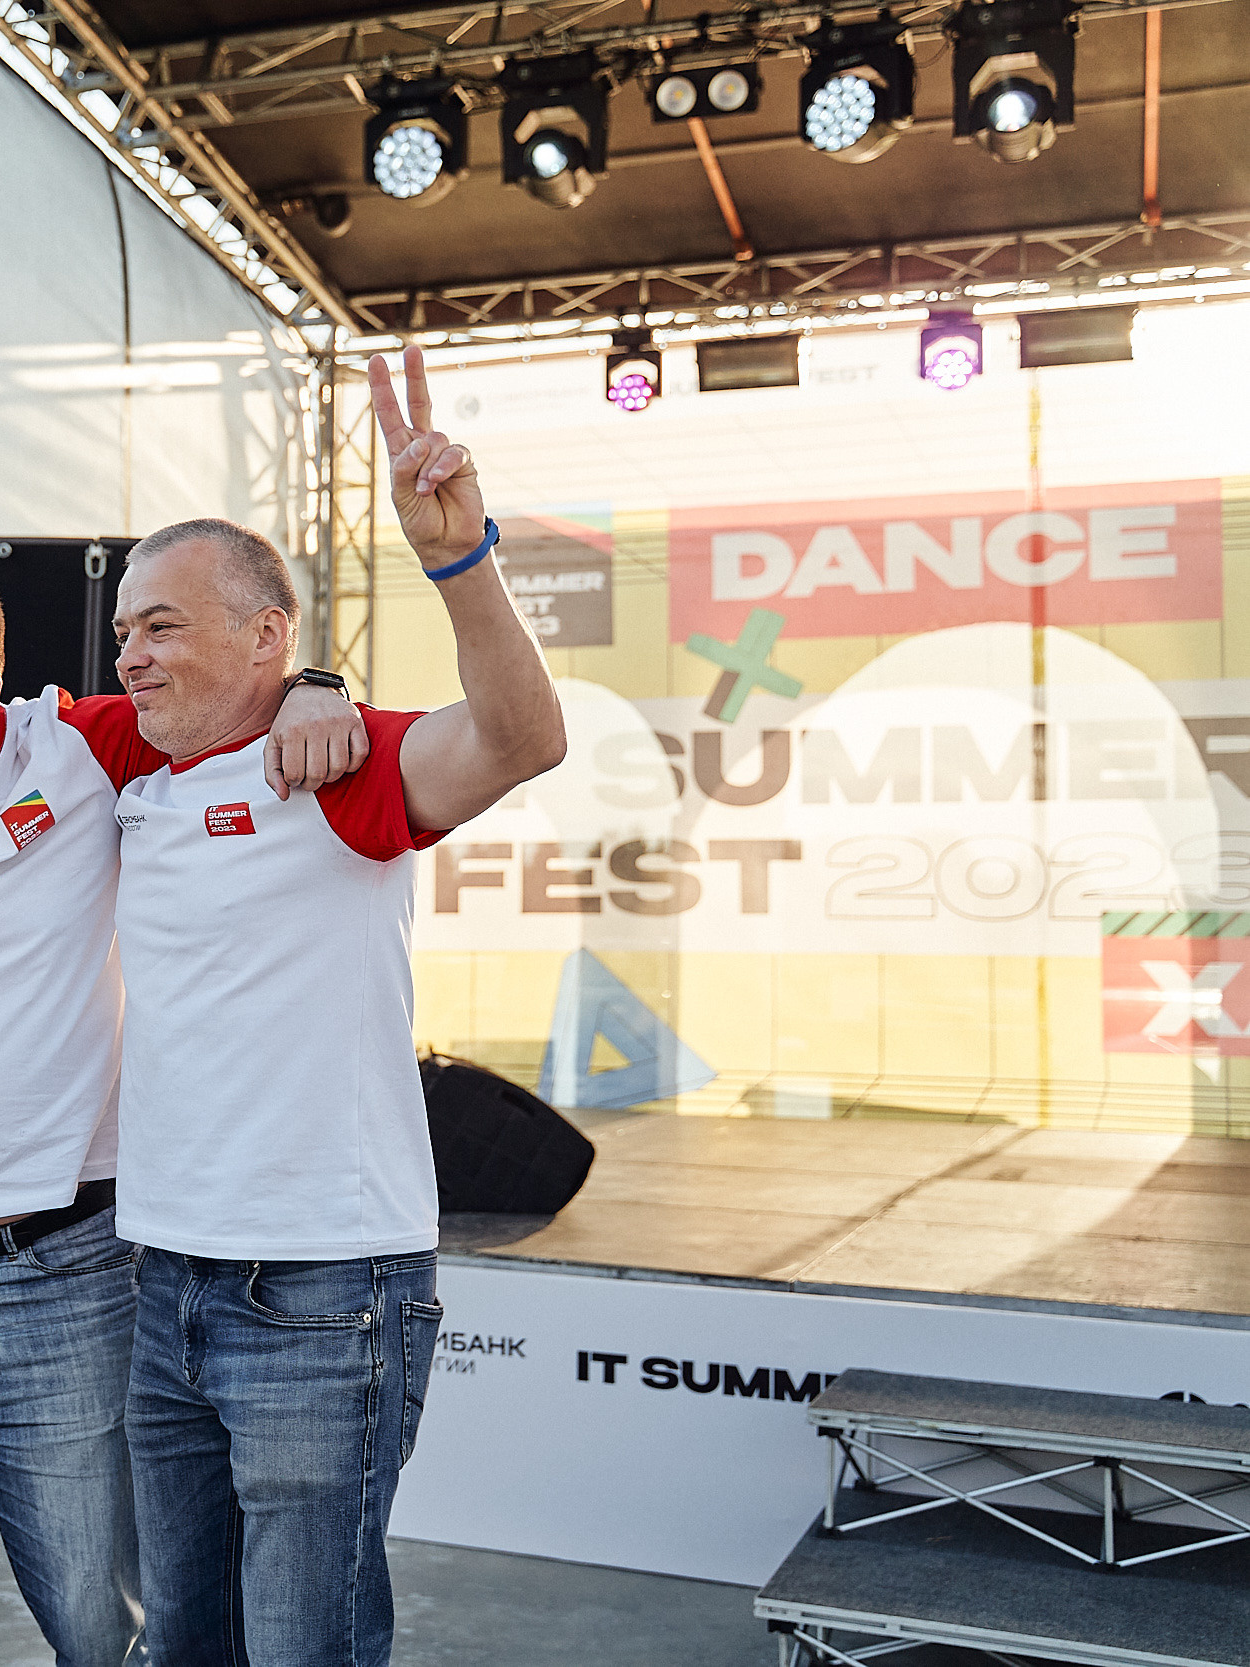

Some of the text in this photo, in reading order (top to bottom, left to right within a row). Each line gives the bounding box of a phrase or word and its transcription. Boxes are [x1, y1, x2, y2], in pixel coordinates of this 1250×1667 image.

[711, 505, 1177, 601] DANCE
[592, 717, 1250, 808] SUMMER
[13, 810, 49, 836] SUMMER
[208, 810, 248, 819] SUMMER
[10, 822, 19, 832] IT
[16, 825, 38, 842] FEST
[211, 825, 237, 833] 2023
[20, 830, 42, 848] 2023
[435, 830, 1250, 922] FEST 2023
[577, 1351, 842, 1403] IT SUMM
